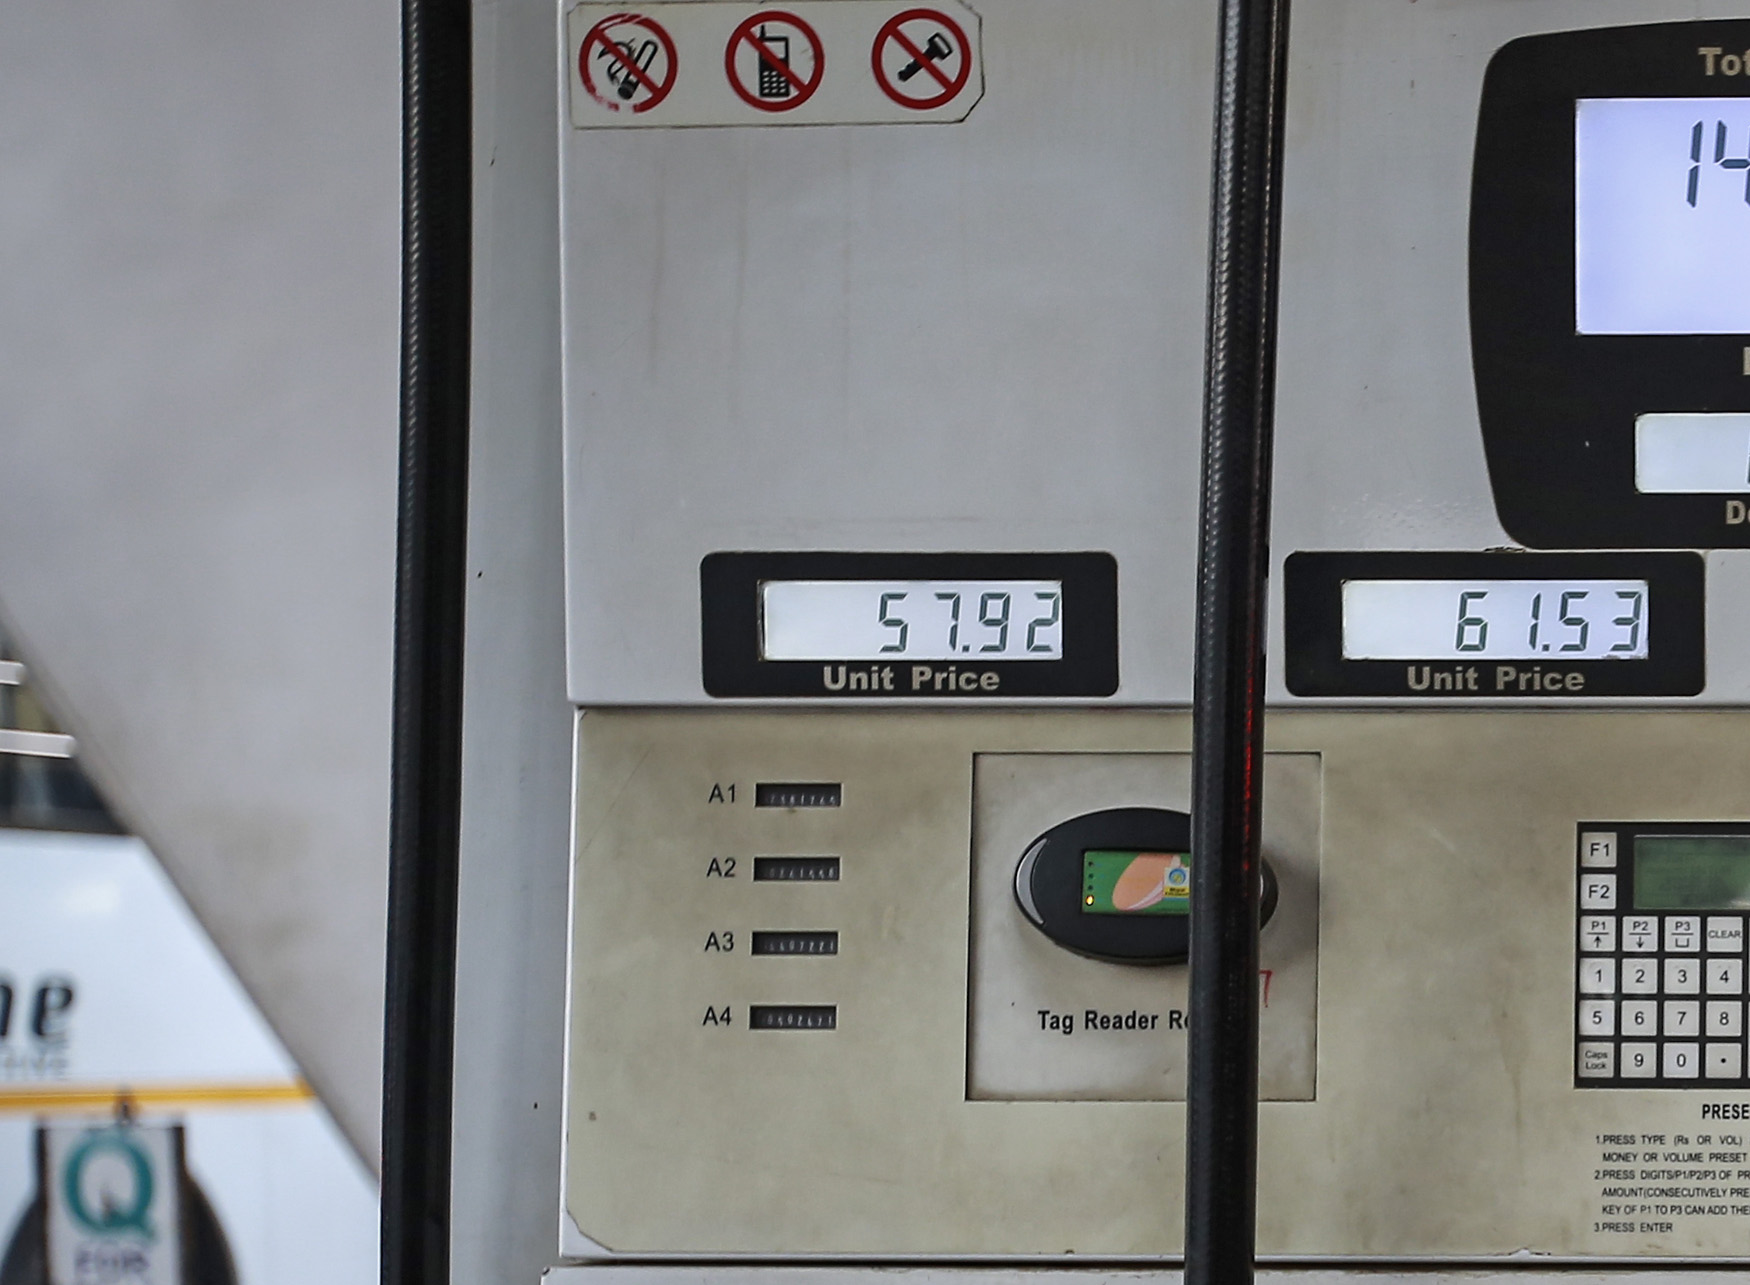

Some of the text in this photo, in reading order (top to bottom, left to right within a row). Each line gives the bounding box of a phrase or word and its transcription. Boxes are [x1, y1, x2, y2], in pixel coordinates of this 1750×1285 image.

[878, 592, 1061, 653] 57.92
[1455, 590, 1642, 652] 61.53
[823, 665, 1001, 691] Unit Price
[1407, 666, 1585, 691] Unit Price
[708, 783, 735, 803] A1
[1590, 842, 1610, 857] F1
[706, 857, 736, 878] A2
[1588, 885, 1610, 899] F2
[1591, 921, 1691, 931] P1 P2 P3
[704, 931, 734, 952] A3
[1708, 930, 1741, 939] CLEAR
[1595, 969, 1730, 983] 1 2 3 4
[702, 1005, 731, 1027] A4
[1038, 1010, 1074, 1034] Tag
[1085, 1010, 1158, 1030] Reader
[1592, 1011, 1730, 1025] 5 6 7 8
[1585, 1050, 1608, 1062] Caps
[1634, 1053, 1644, 1067] 9
[1676, 1053, 1686, 1067] 0
[1585, 1061, 1607, 1070] Lock
[1642, 1135, 1666, 1145] TYPE
[1674, 1135, 1689, 1145] (Rs
[1697, 1135, 1711, 1145] OR
[1719, 1135, 1742, 1145] VOL)
[1602, 1152, 1748, 1162] MONEY OR VOLUME PRESET
[1719, 1170, 1732, 1180] OF
[64, 1126, 156, 1242] Q
[1602, 1205, 1621, 1215] KEY
[1624, 1205, 1638, 1215] OF
[1640, 1205, 1651, 1215] P1
[1655, 1205, 1668, 1215] TO
[1670, 1205, 1683, 1215] P3
[1684, 1205, 1706, 1215] CAN
[1707, 1205, 1728, 1215] ADD
[1640, 1222, 1673, 1232] ENTER
